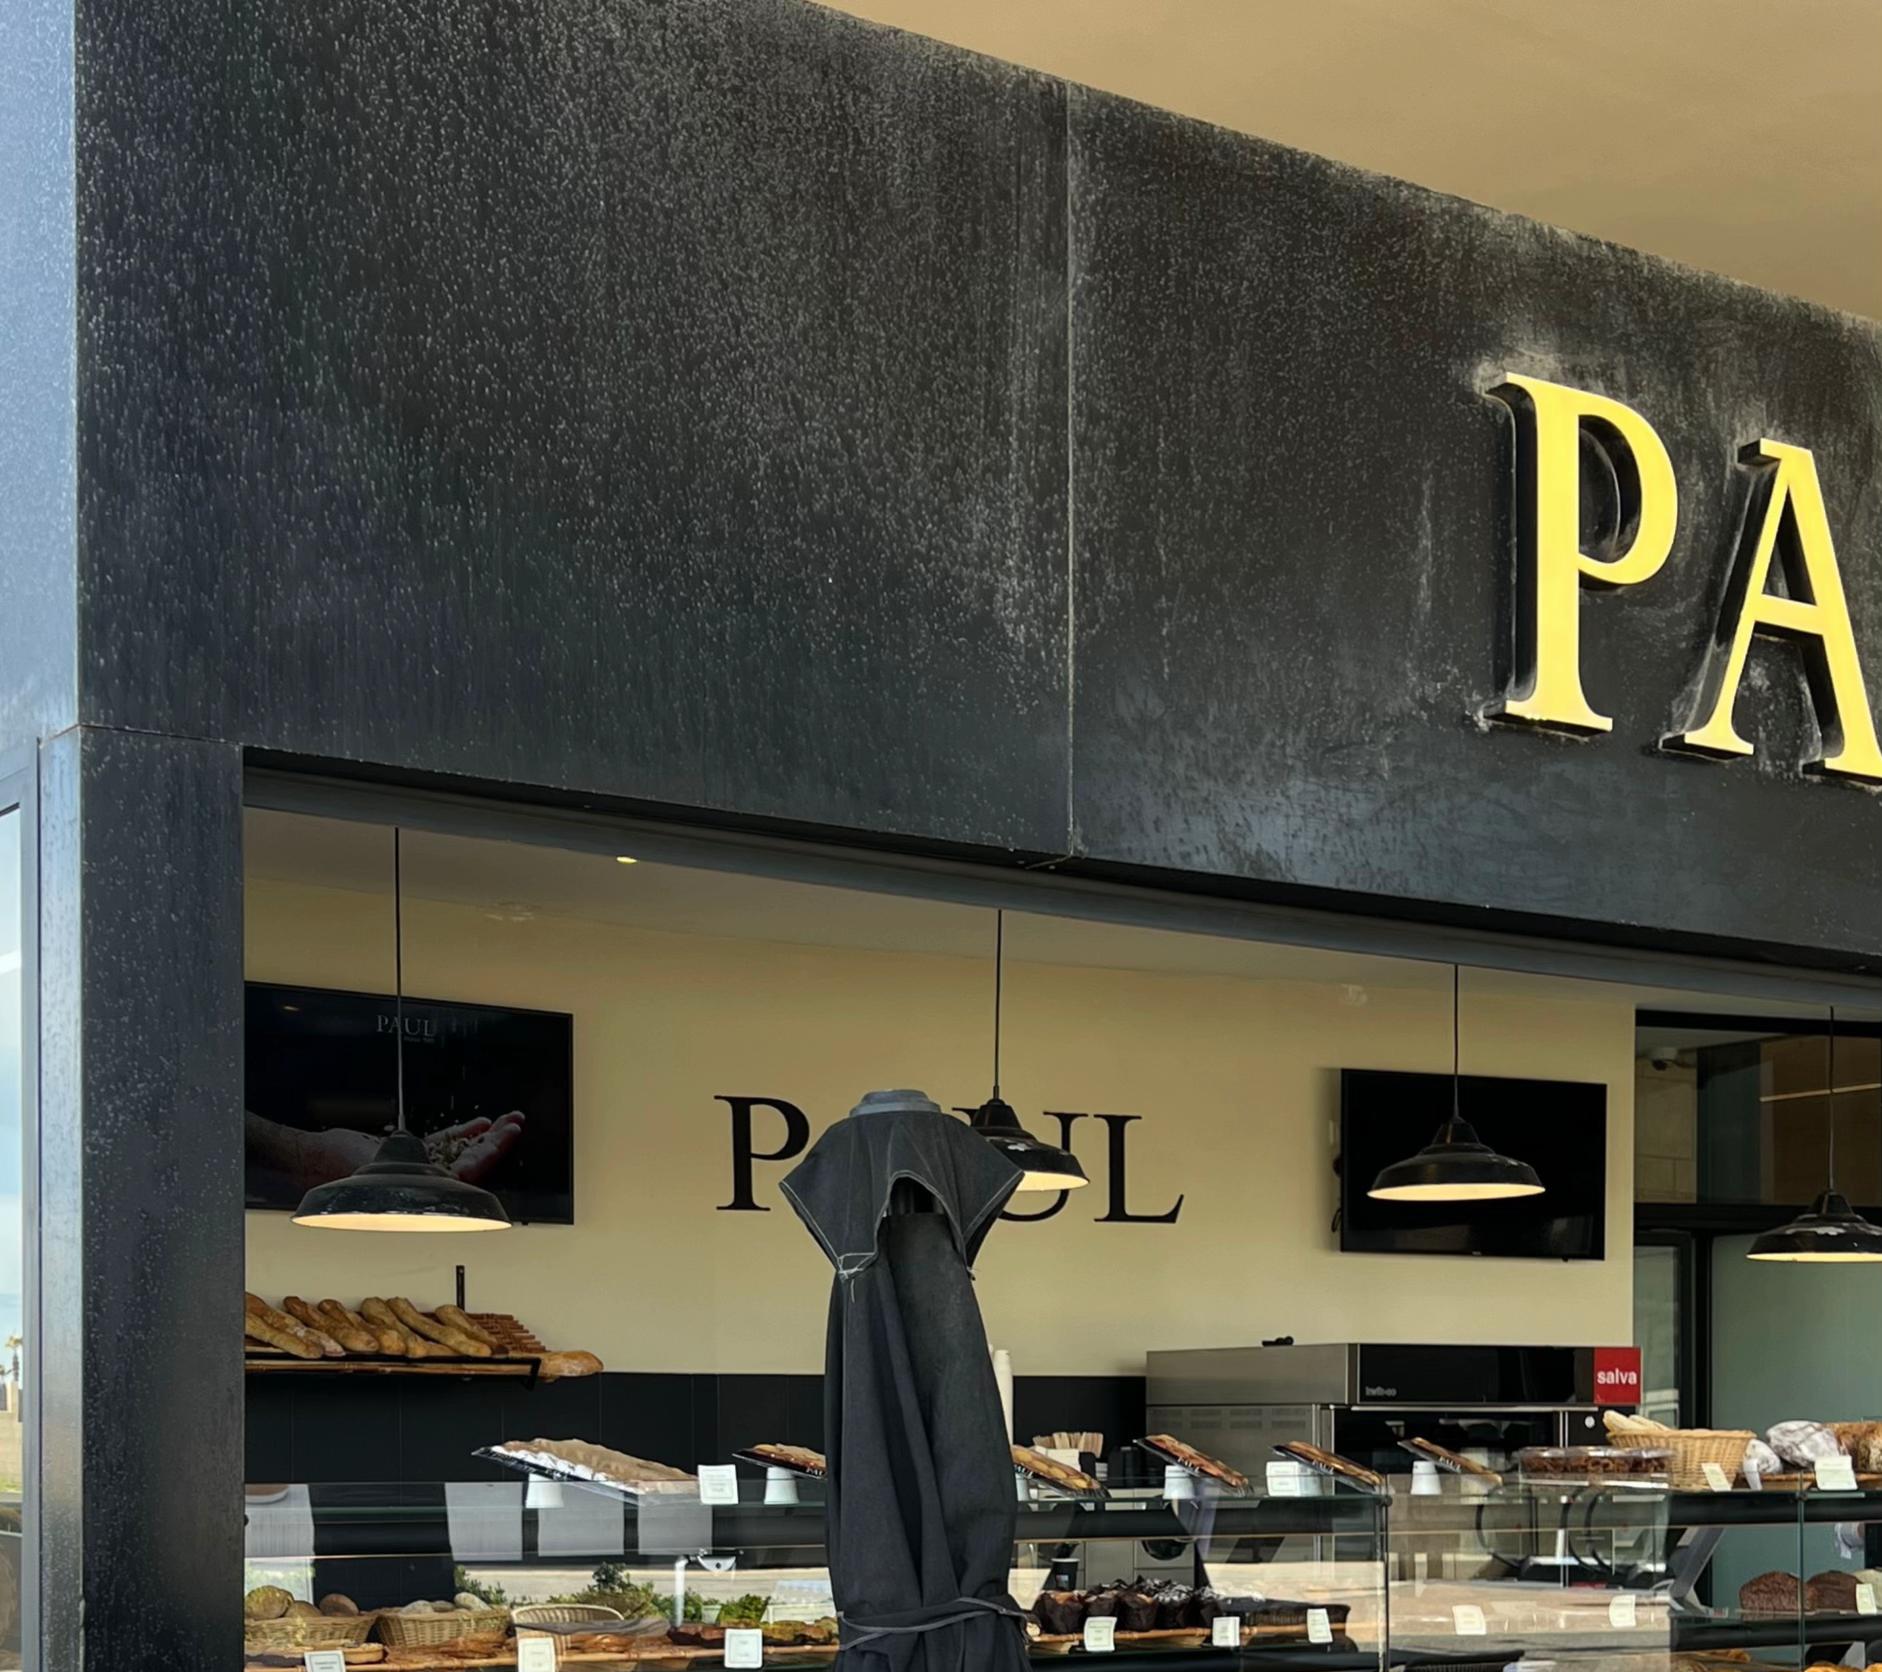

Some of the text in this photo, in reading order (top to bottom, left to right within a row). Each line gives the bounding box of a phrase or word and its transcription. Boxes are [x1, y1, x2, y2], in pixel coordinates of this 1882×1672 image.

[1505, 371, 1882, 779] PA
[376, 1014, 436, 1037] PAUL
[714, 1096, 1184, 1224] PUL
[1597, 1368, 1637, 1385] salva
